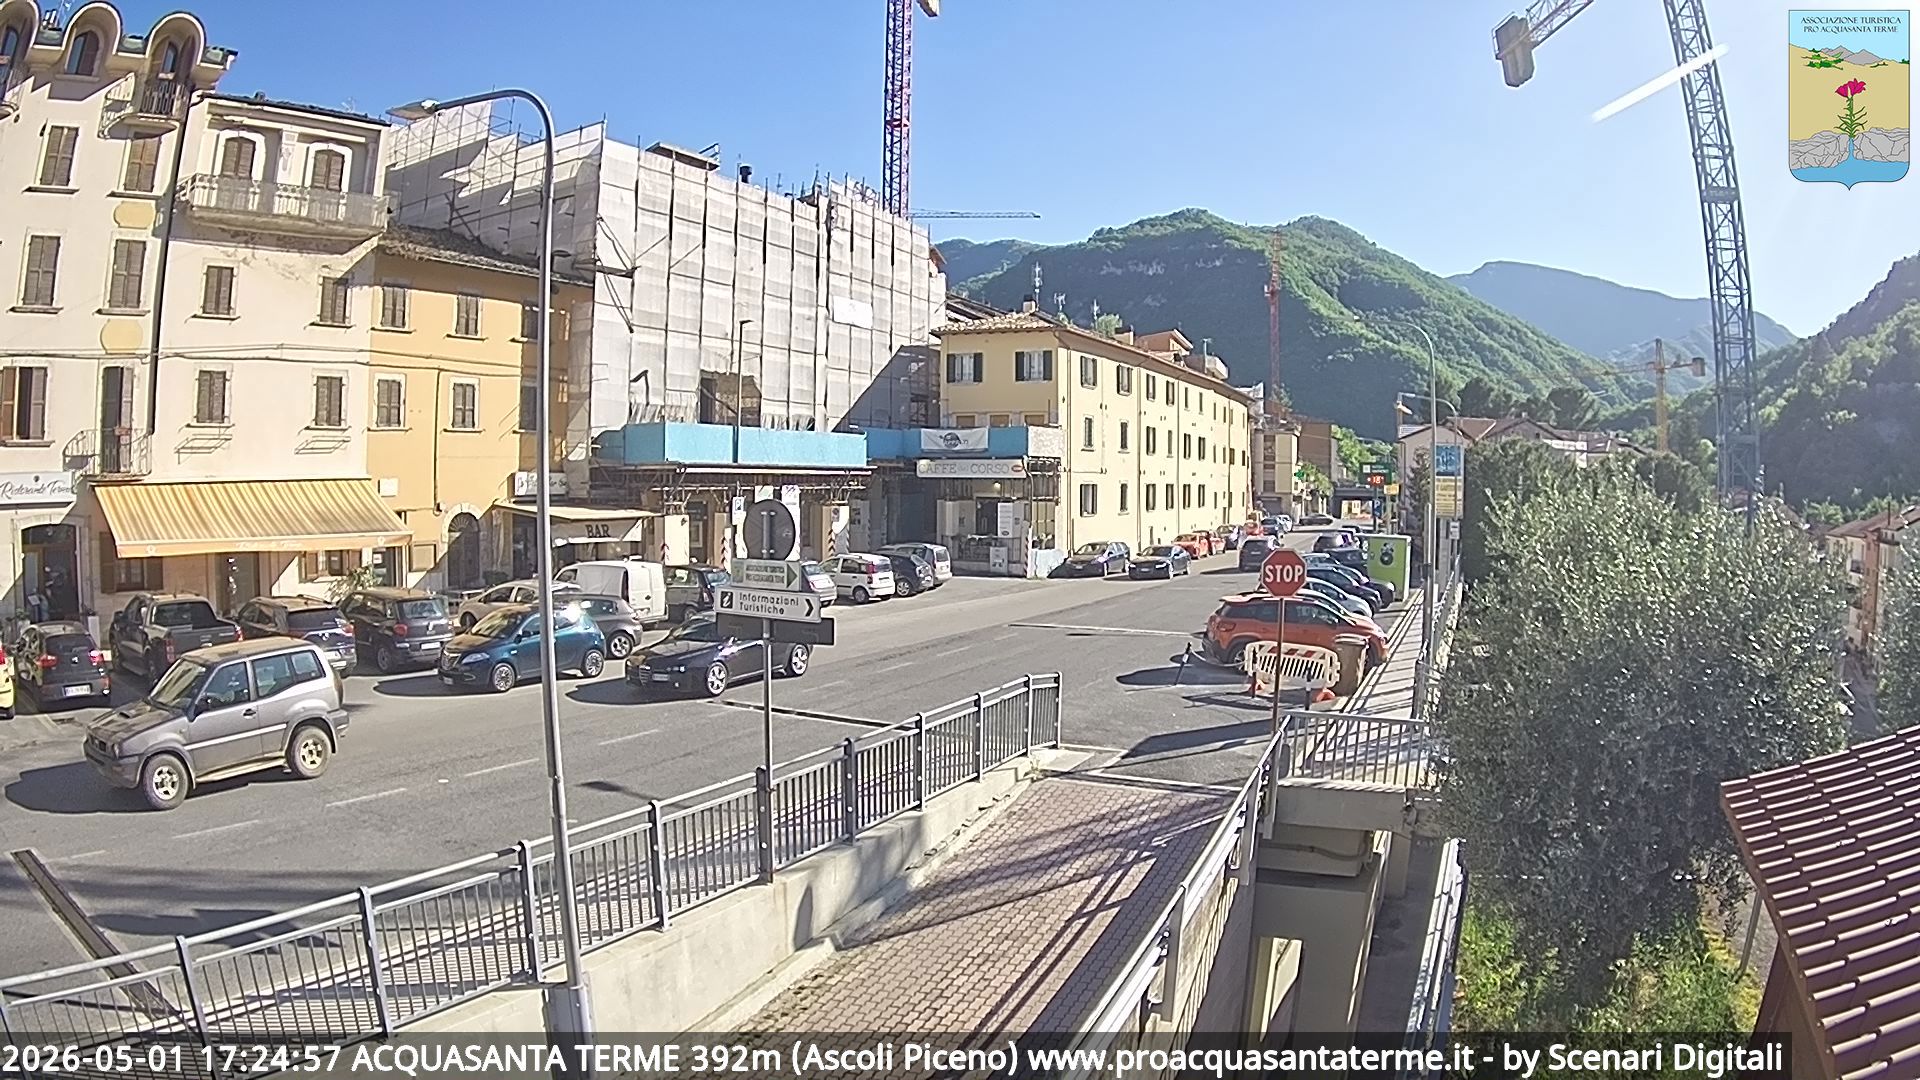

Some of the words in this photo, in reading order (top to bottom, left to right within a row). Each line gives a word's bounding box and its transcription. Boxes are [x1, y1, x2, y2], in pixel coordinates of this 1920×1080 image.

[970, 463, 1010, 474] CORSO
[585, 524, 611, 538] BAR
[1265, 564, 1304, 583] STOP
[739, 592, 799, 606] Informazioni
[739, 602, 784, 615] Turistiche
